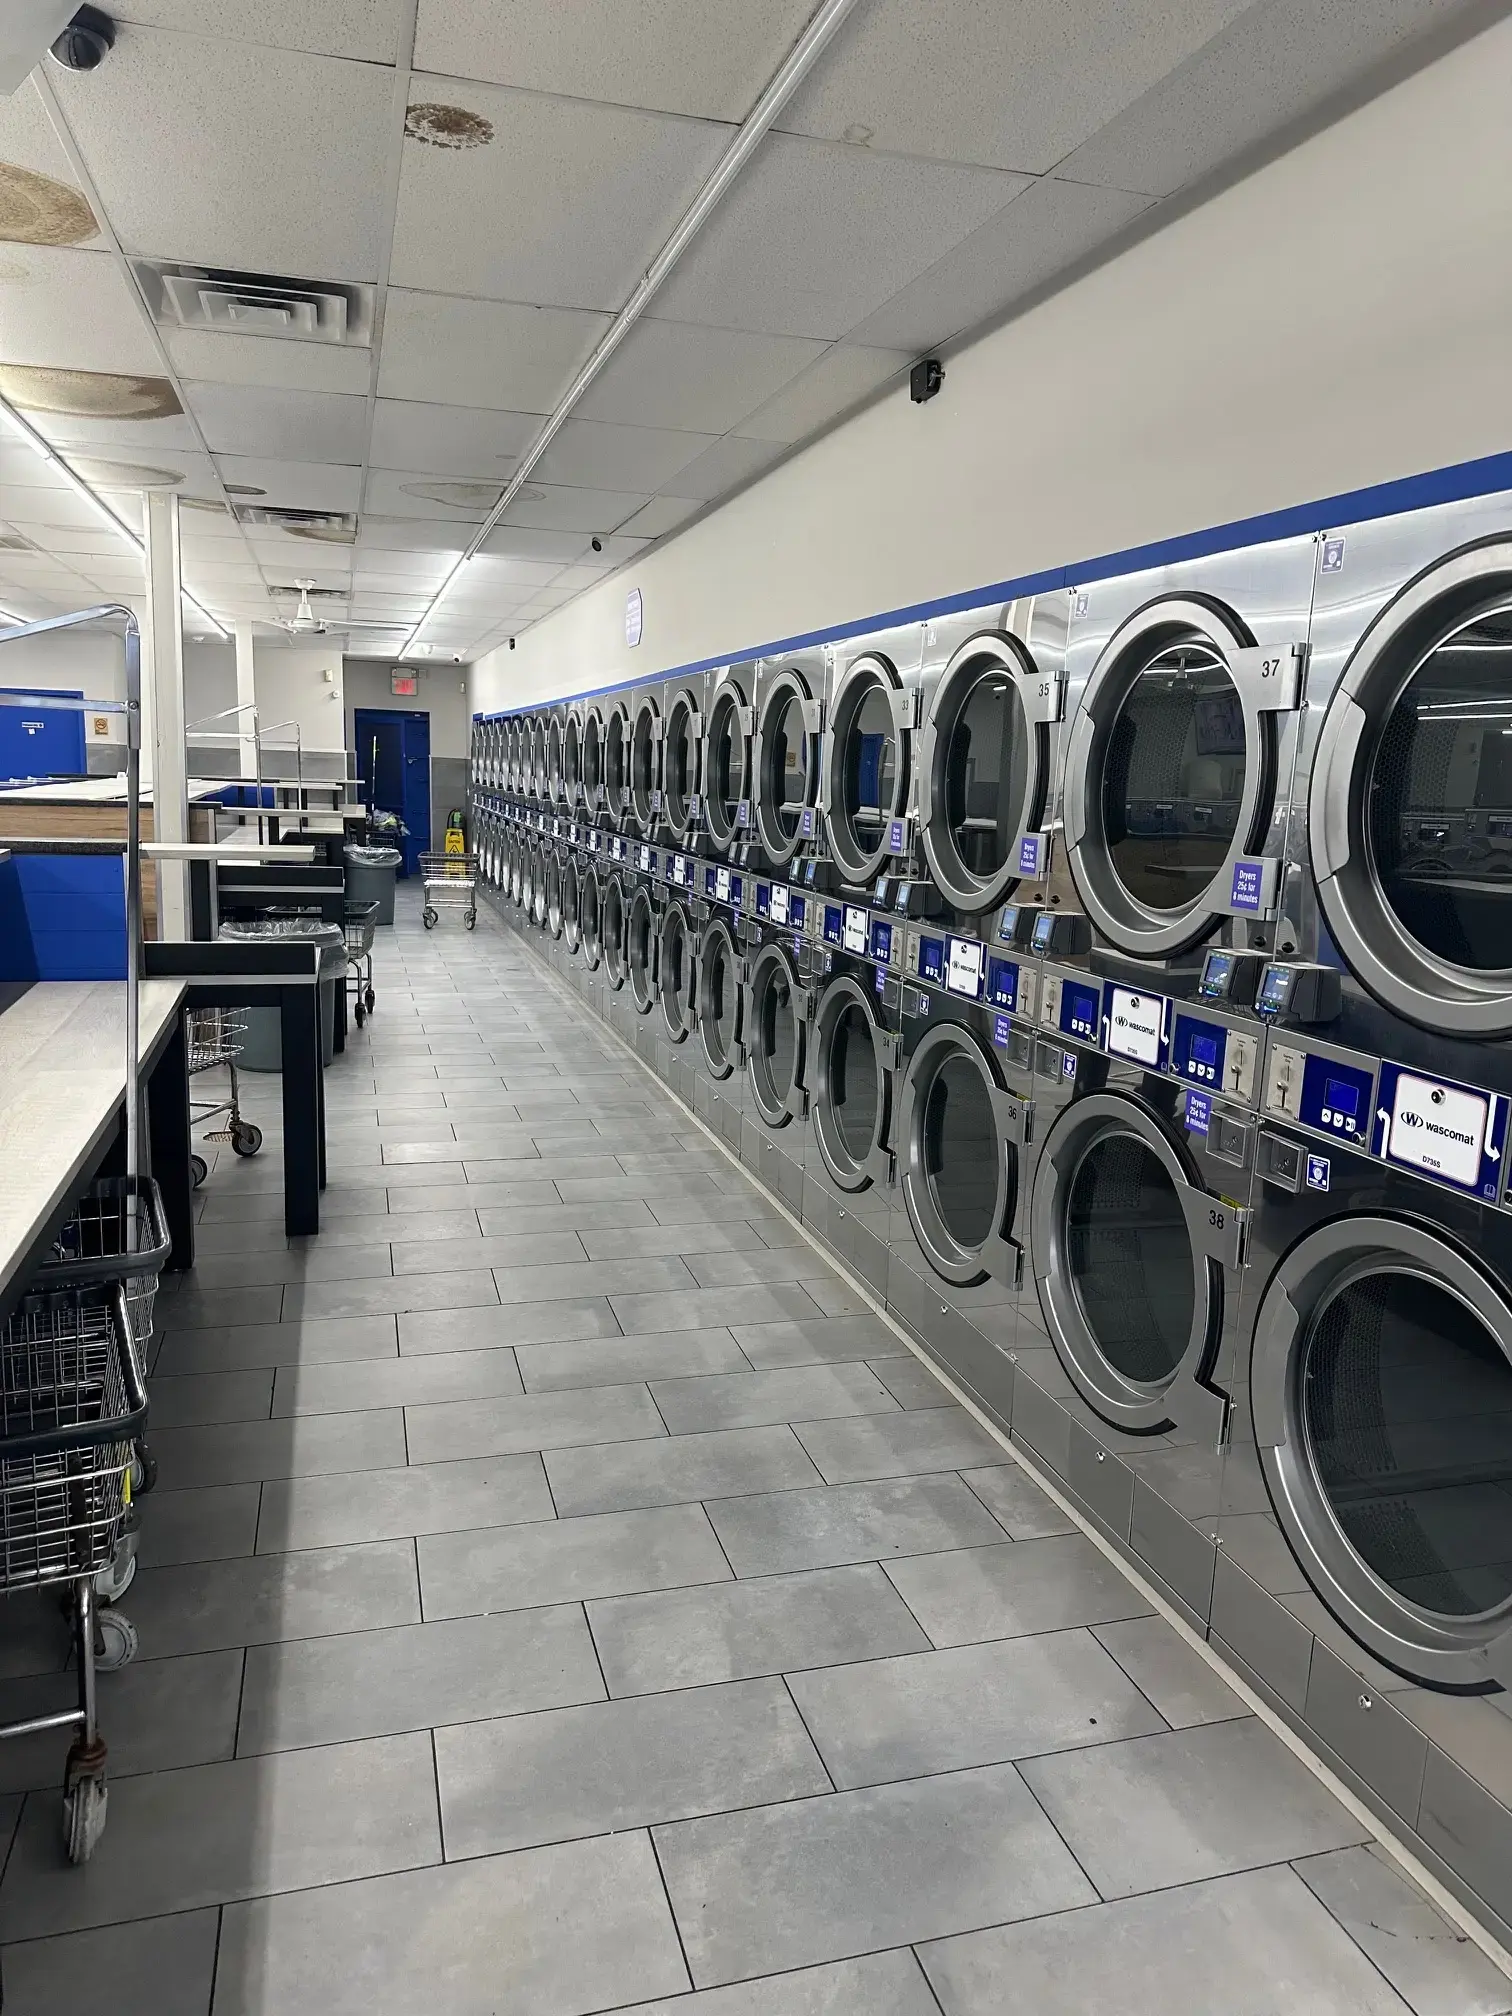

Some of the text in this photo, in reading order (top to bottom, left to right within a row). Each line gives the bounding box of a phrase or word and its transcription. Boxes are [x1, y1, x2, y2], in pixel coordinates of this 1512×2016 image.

[1262, 659, 1280, 678] 37
[1038, 682, 1050, 697] 35
[1239, 870, 1256, 881] Dryers
[1237, 880, 1247, 891] 25¢
[1233, 891, 1258, 903] 8 minutes
[1128, 1021, 1156, 1036] wascomat
[1190, 1096, 1206, 1109] Dryers
[1008, 1105, 1017, 1120] 36
[1190, 1106, 1198, 1117] 25¢
[1190, 1117, 1208, 1131] minutes
[1426, 1121, 1474, 1146] wascomat
[1422, 1155, 1441, 1168] D735S
[1209, 1209, 1224, 1230] 38
